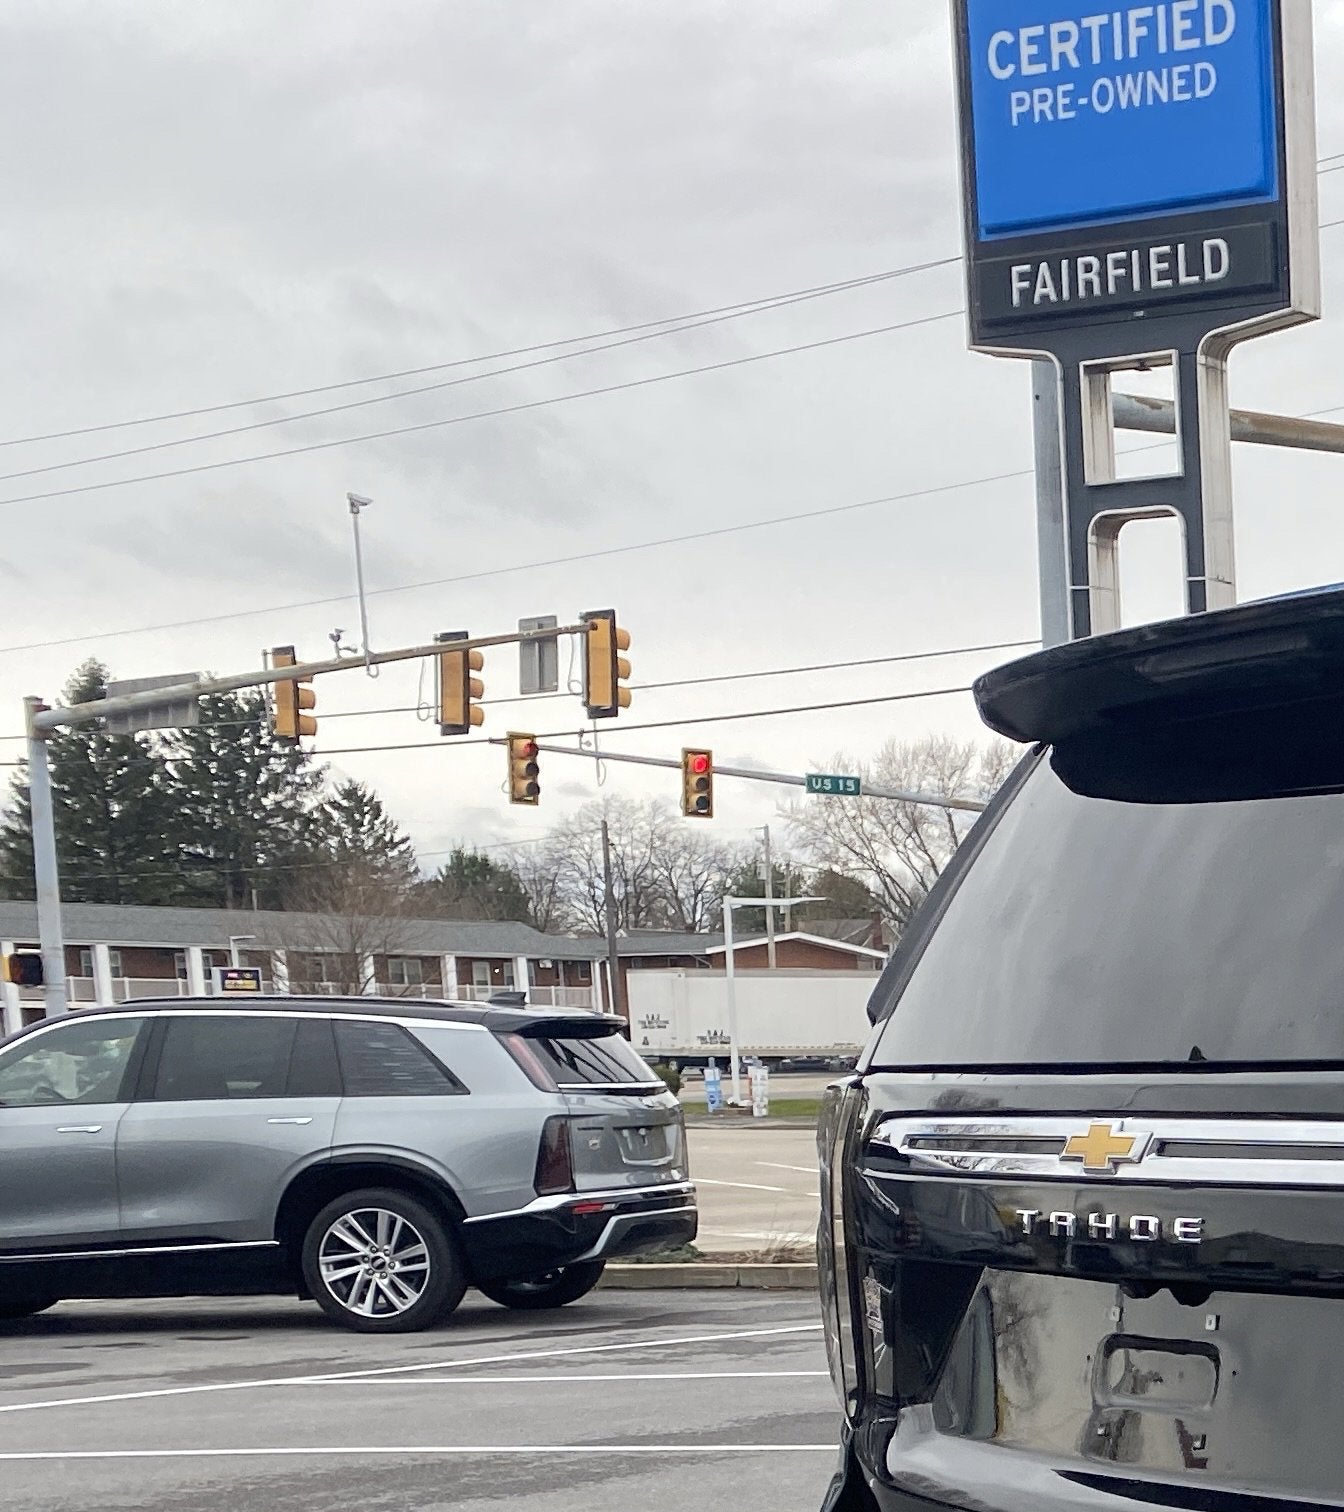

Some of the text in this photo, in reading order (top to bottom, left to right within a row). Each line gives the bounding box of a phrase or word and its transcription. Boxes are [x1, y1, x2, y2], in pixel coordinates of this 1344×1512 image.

[988, 0, 1236, 80] CERTIFIED
[1011, 62, 1217, 126] PRE-OWNED
[1010, 238, 1231, 307] FAIRFIELD
[812, 777, 855, 792] US 15
[1016, 1208, 1205, 1244] TAHOE
